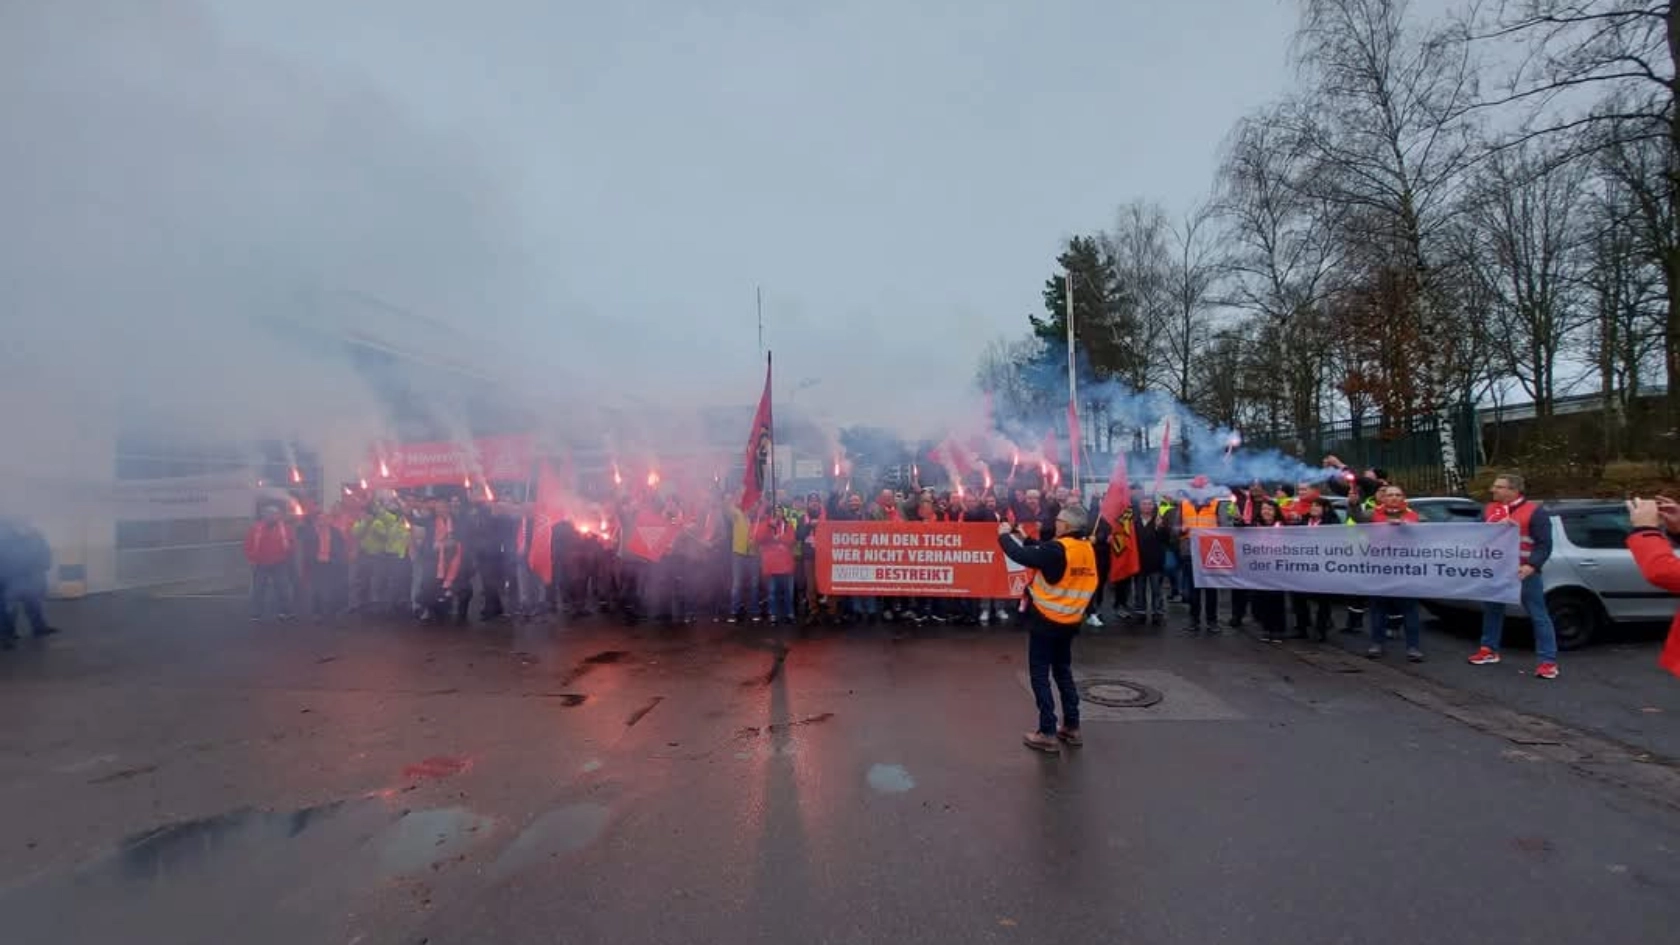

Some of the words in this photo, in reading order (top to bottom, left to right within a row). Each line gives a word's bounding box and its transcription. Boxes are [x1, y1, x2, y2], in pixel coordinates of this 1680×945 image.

[832, 532, 868, 545] BOGE
[870, 533, 889, 546] AN
[893, 533, 919, 547] DEN
[922, 534, 962, 547] TISCH
[832, 548, 860, 562] WER
[864, 549, 904, 562] NICHT
[907, 550, 995, 564] VERHANDELT
[1242, 543, 1320, 556] Betriebsrat
[1324, 544, 1354, 557] und
[1359, 544, 1504, 560] Vertrauensleute
[875, 568, 951, 581] BESTREIKT
[1249, 560, 1271, 571] der
[1275, 560, 1320, 573] Firma
[1325, 560, 1427, 576] Continental
[1434, 563, 1494, 579] Teves
